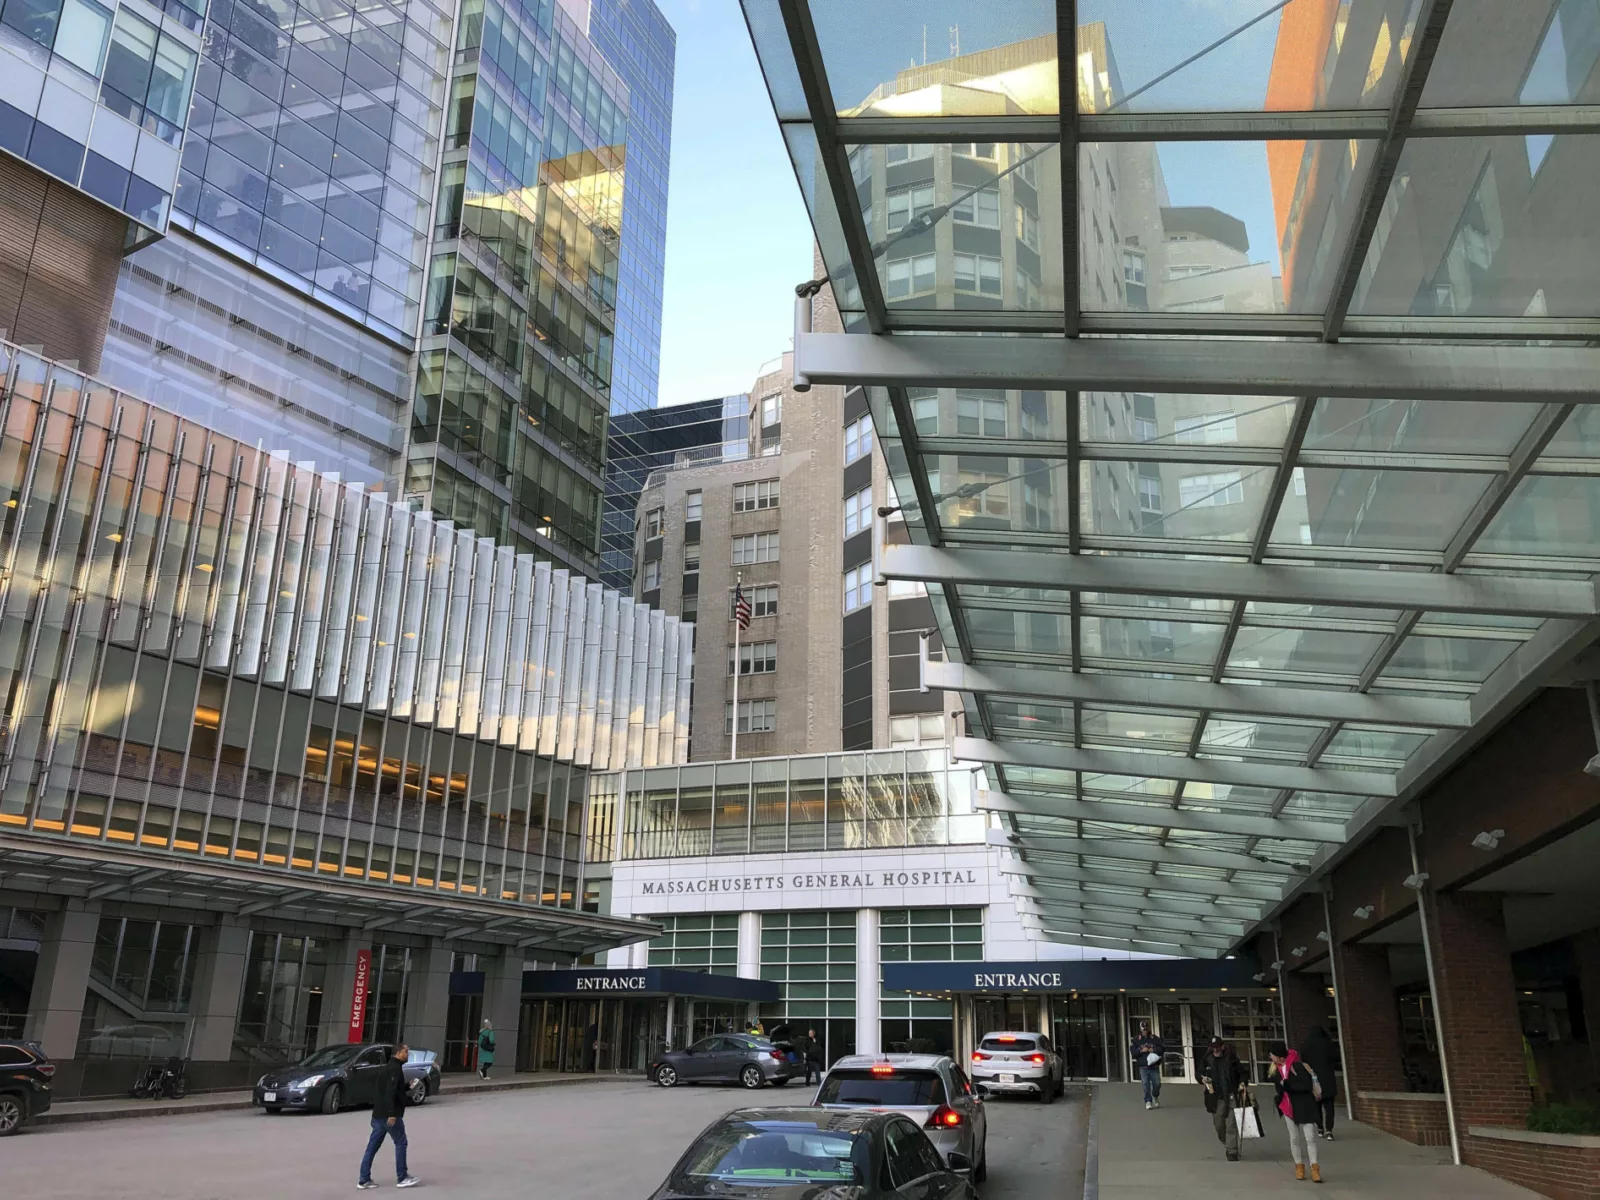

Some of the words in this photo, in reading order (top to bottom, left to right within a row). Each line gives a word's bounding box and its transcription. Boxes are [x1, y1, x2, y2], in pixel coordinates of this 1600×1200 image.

[642, 876, 785, 895] MASSACHUSETTS
[792, 873, 874, 889] GENERAL
[883, 870, 977, 886] HOSPITAL
[576, 976, 646, 990] ENTRANCE
[974, 973, 1062, 987] ENTRANCE
[352, 956, 366, 1028] EMERGENCY
